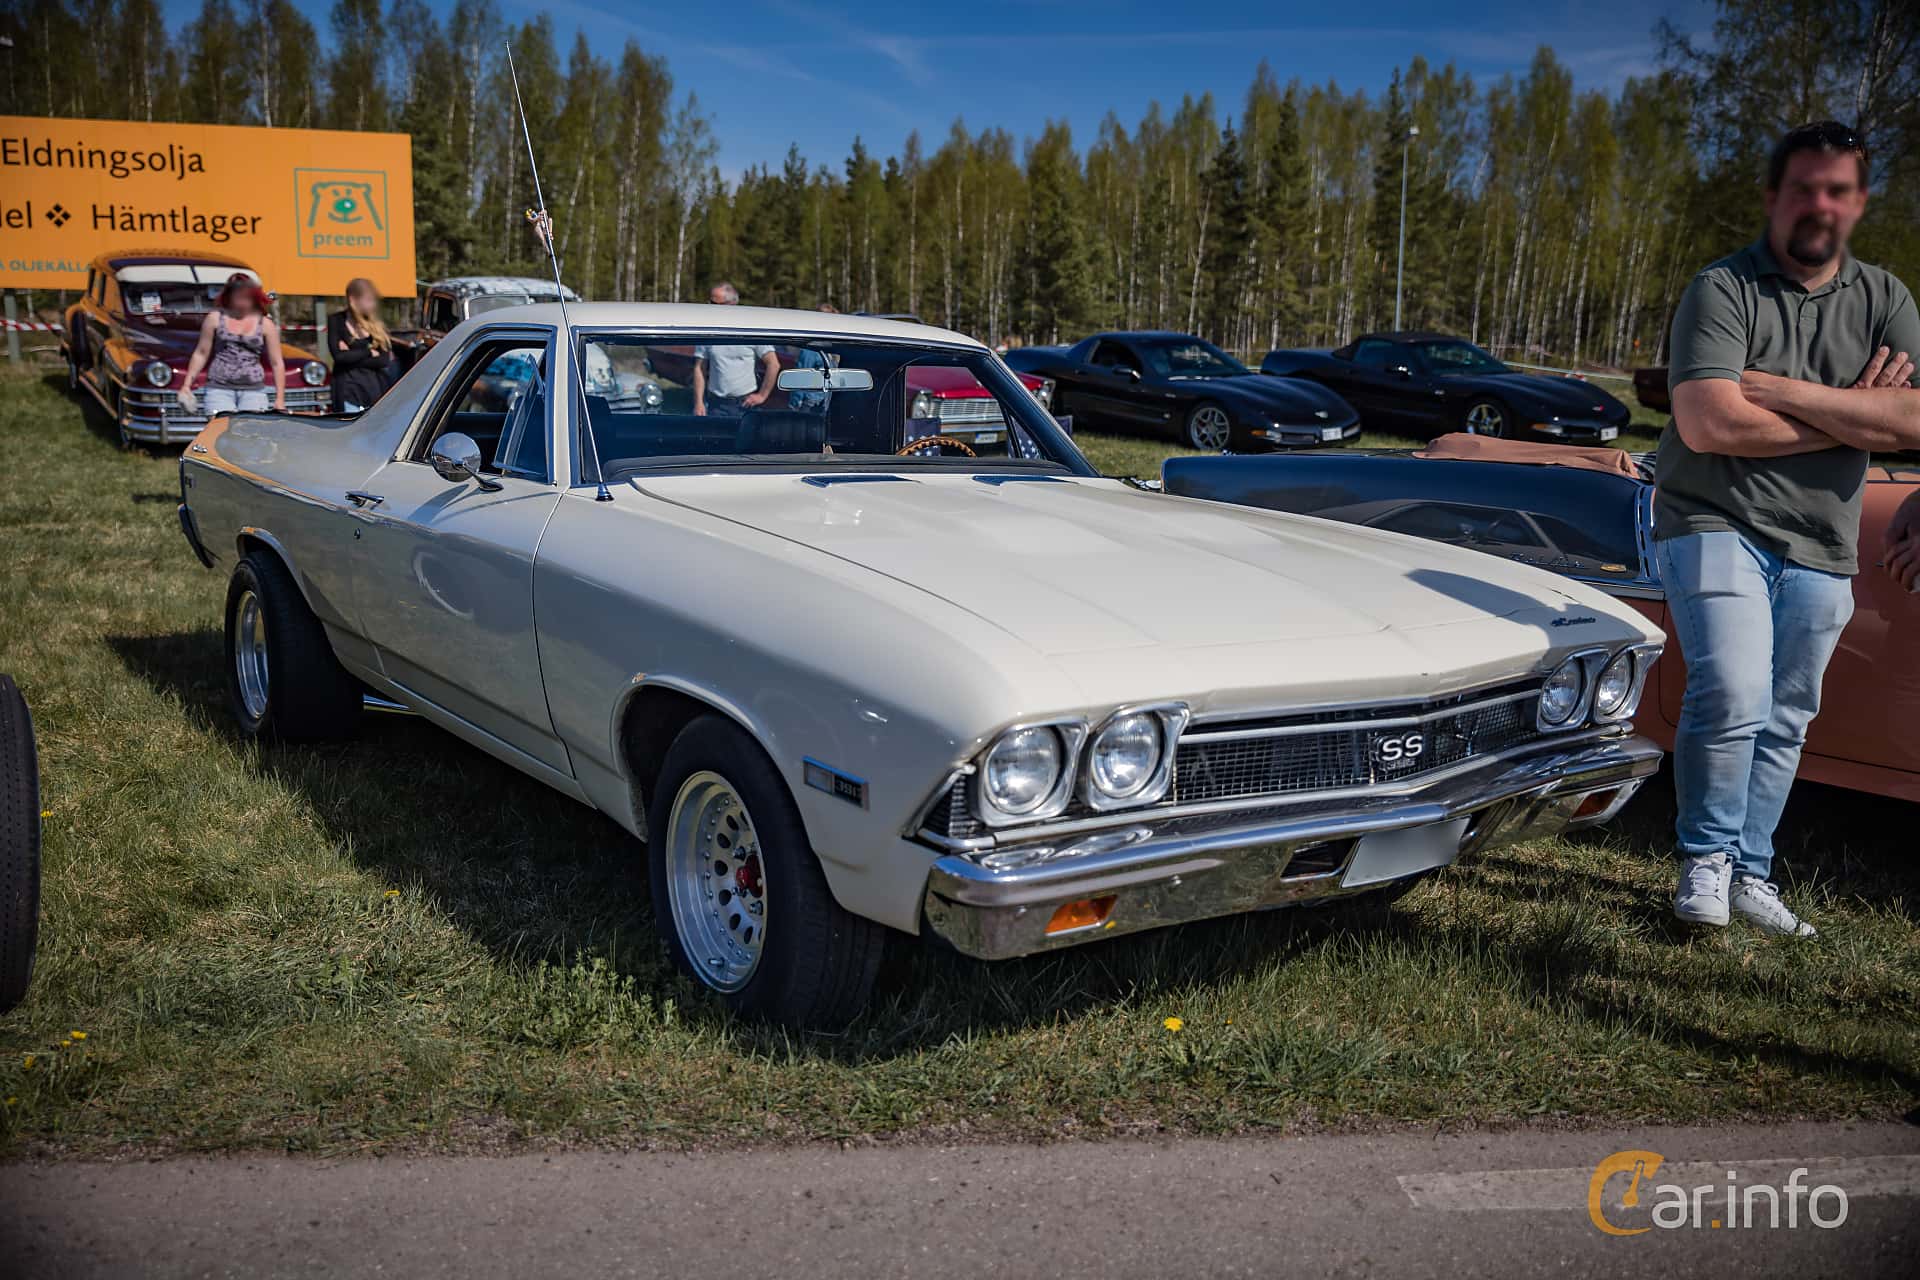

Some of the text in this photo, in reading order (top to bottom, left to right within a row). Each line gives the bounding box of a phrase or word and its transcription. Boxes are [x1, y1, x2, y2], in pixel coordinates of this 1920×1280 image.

[1, 137, 206, 180] Eldningsolja
[92, 203, 263, 243] Hämtlager
[312, 230, 374, 248] preem
[1381, 735, 1423, 761] SS
